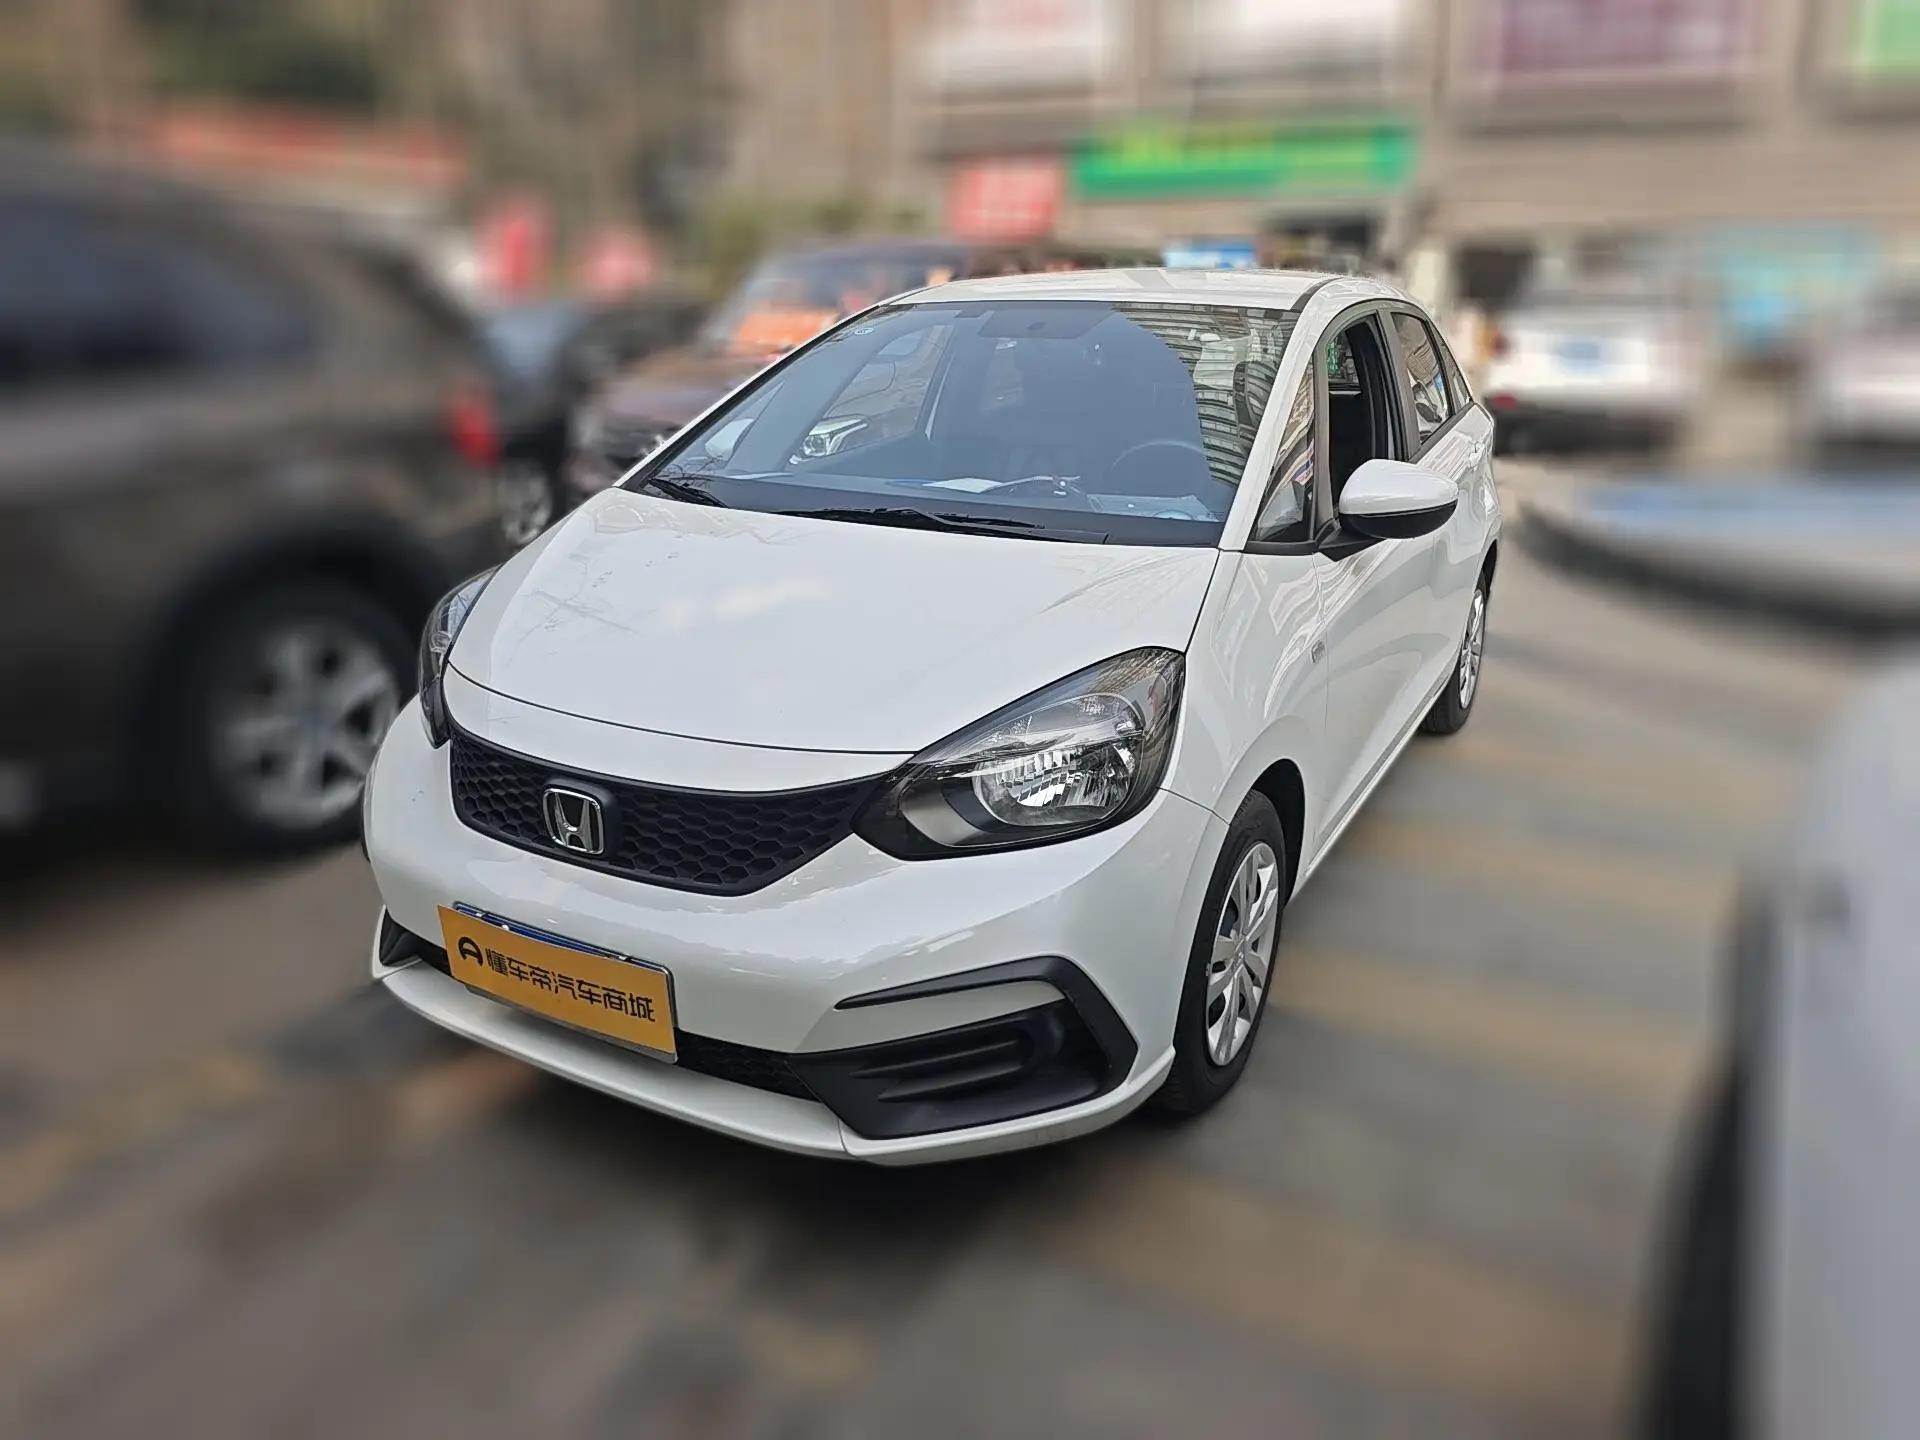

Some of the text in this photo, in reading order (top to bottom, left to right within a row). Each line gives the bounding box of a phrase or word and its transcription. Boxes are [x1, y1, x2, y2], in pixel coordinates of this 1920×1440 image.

[485, 948, 656, 1023] 懂车帝汽车商城
